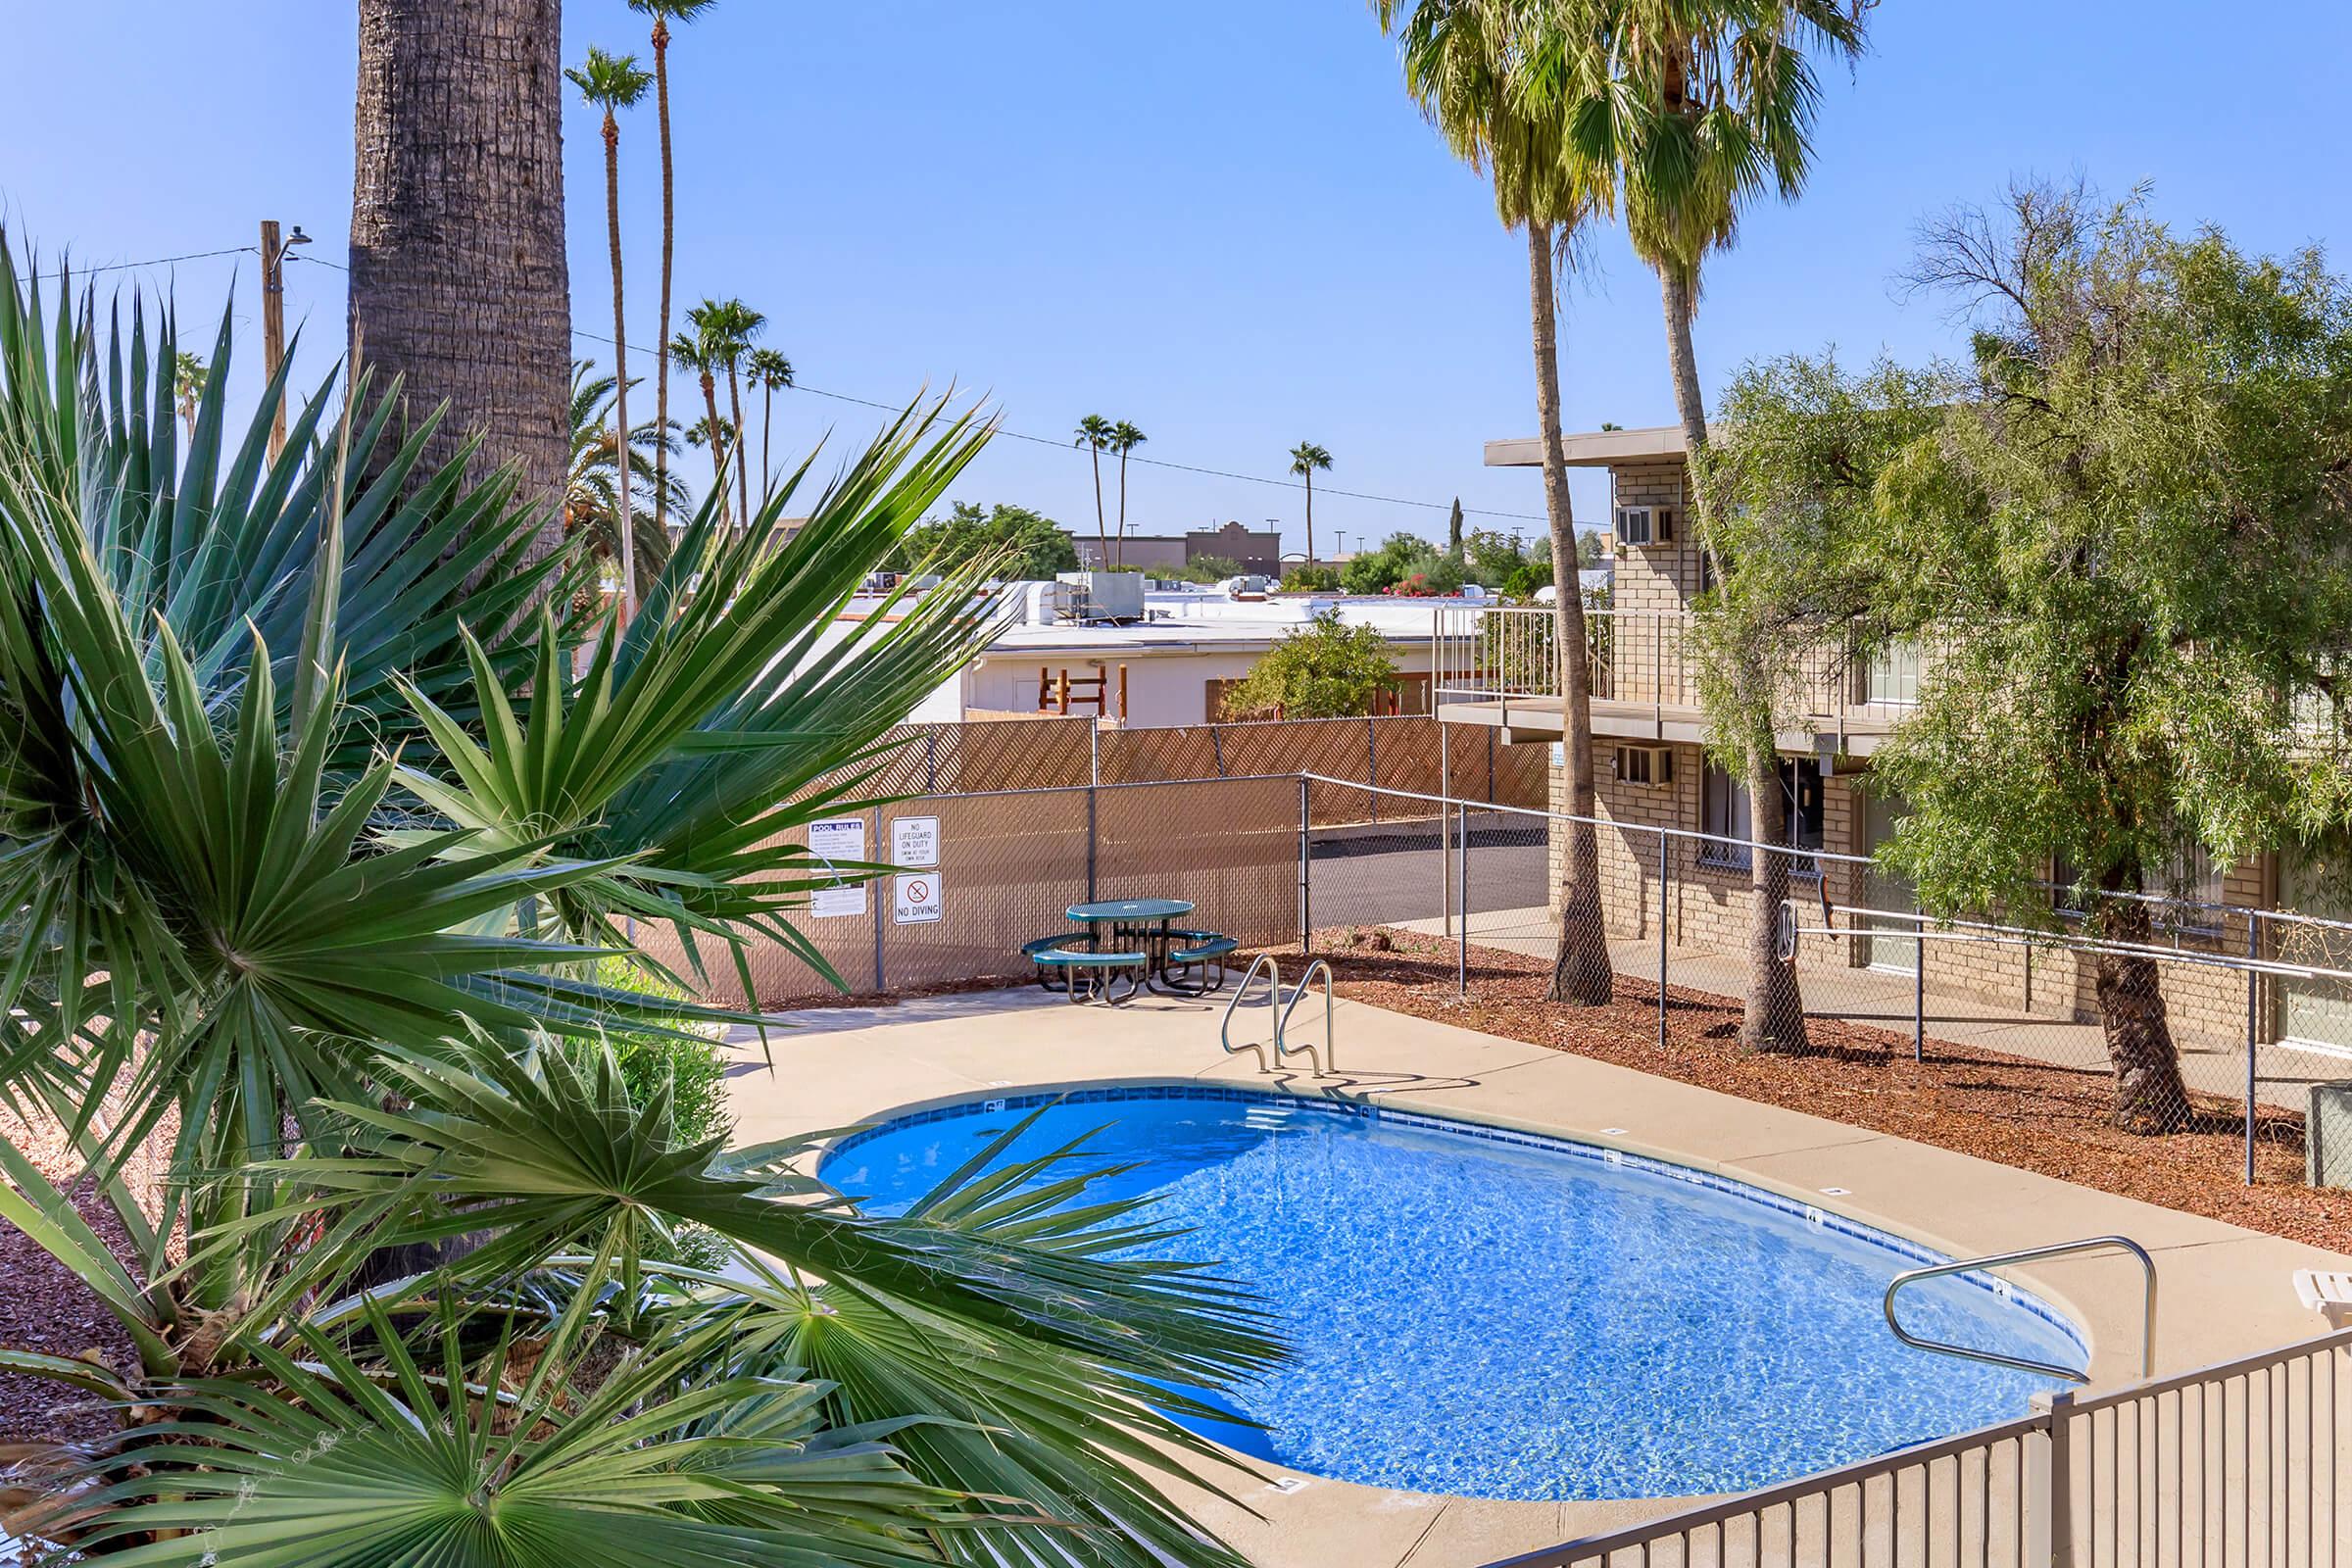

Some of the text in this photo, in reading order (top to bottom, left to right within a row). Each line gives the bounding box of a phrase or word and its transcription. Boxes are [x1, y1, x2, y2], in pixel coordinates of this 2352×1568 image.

[836, 822, 861, 831] RULES
[899, 831, 932, 841] LIFEGUARD
[912, 840, 928, 849] DUTY
[898, 905, 939, 917] NO DIVING
[985, 1102, 995, 1113] 6
